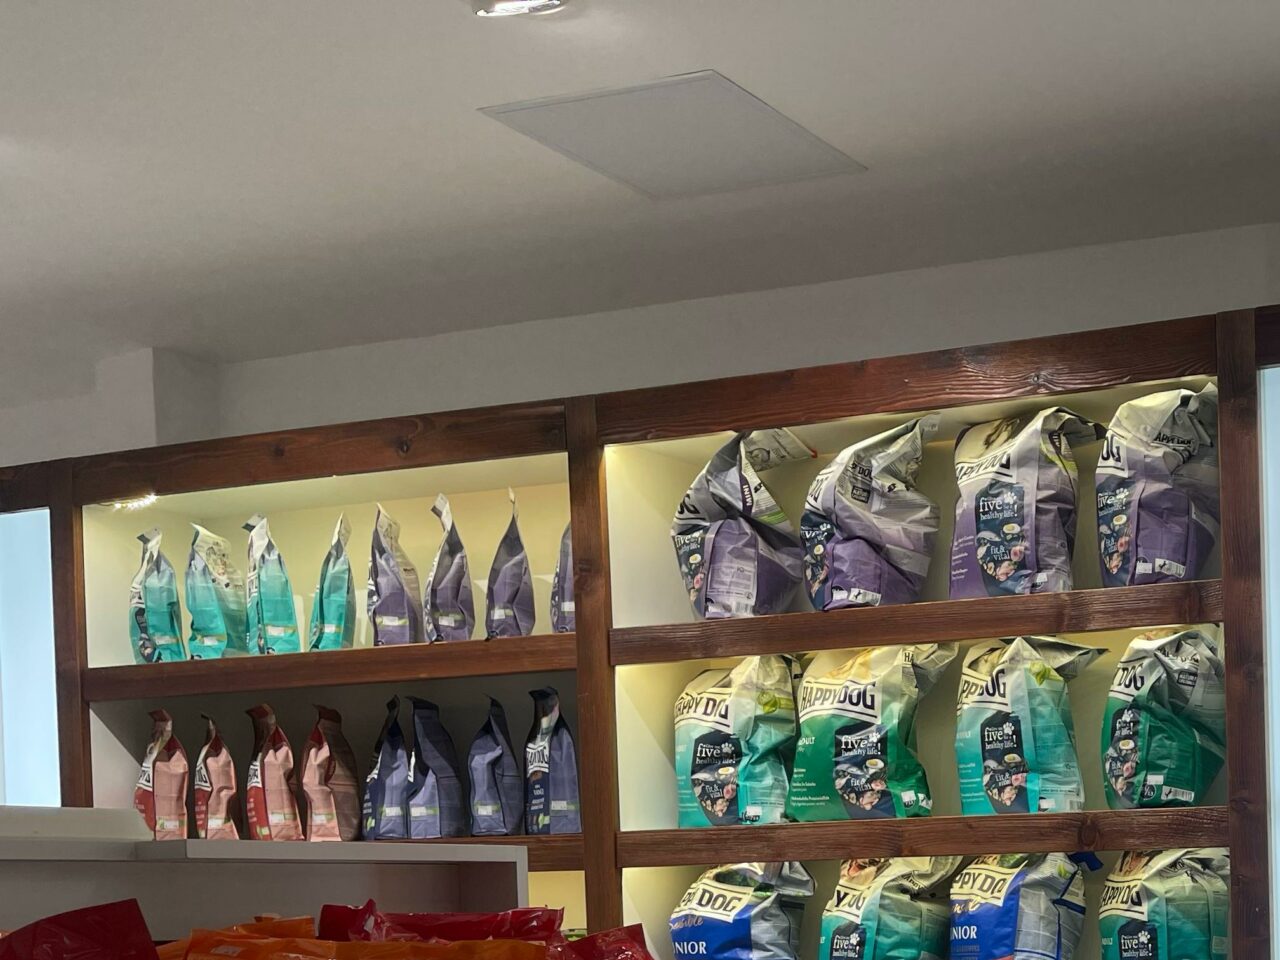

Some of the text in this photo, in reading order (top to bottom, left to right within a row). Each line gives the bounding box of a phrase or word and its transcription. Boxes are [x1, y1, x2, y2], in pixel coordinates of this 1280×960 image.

[979, 498, 1002, 512] five
[980, 510, 1003, 521] healthy
[800, 681, 876, 713] HAPPY DOG
[985, 726, 1003, 742] five
[841, 735, 868, 750] five
[696, 743, 721, 757] five
[695, 888, 742, 913] DOG
[674, 941, 707, 955] NIOR
[833, 934, 849, 948] five
[1121, 935, 1138, 949] five
